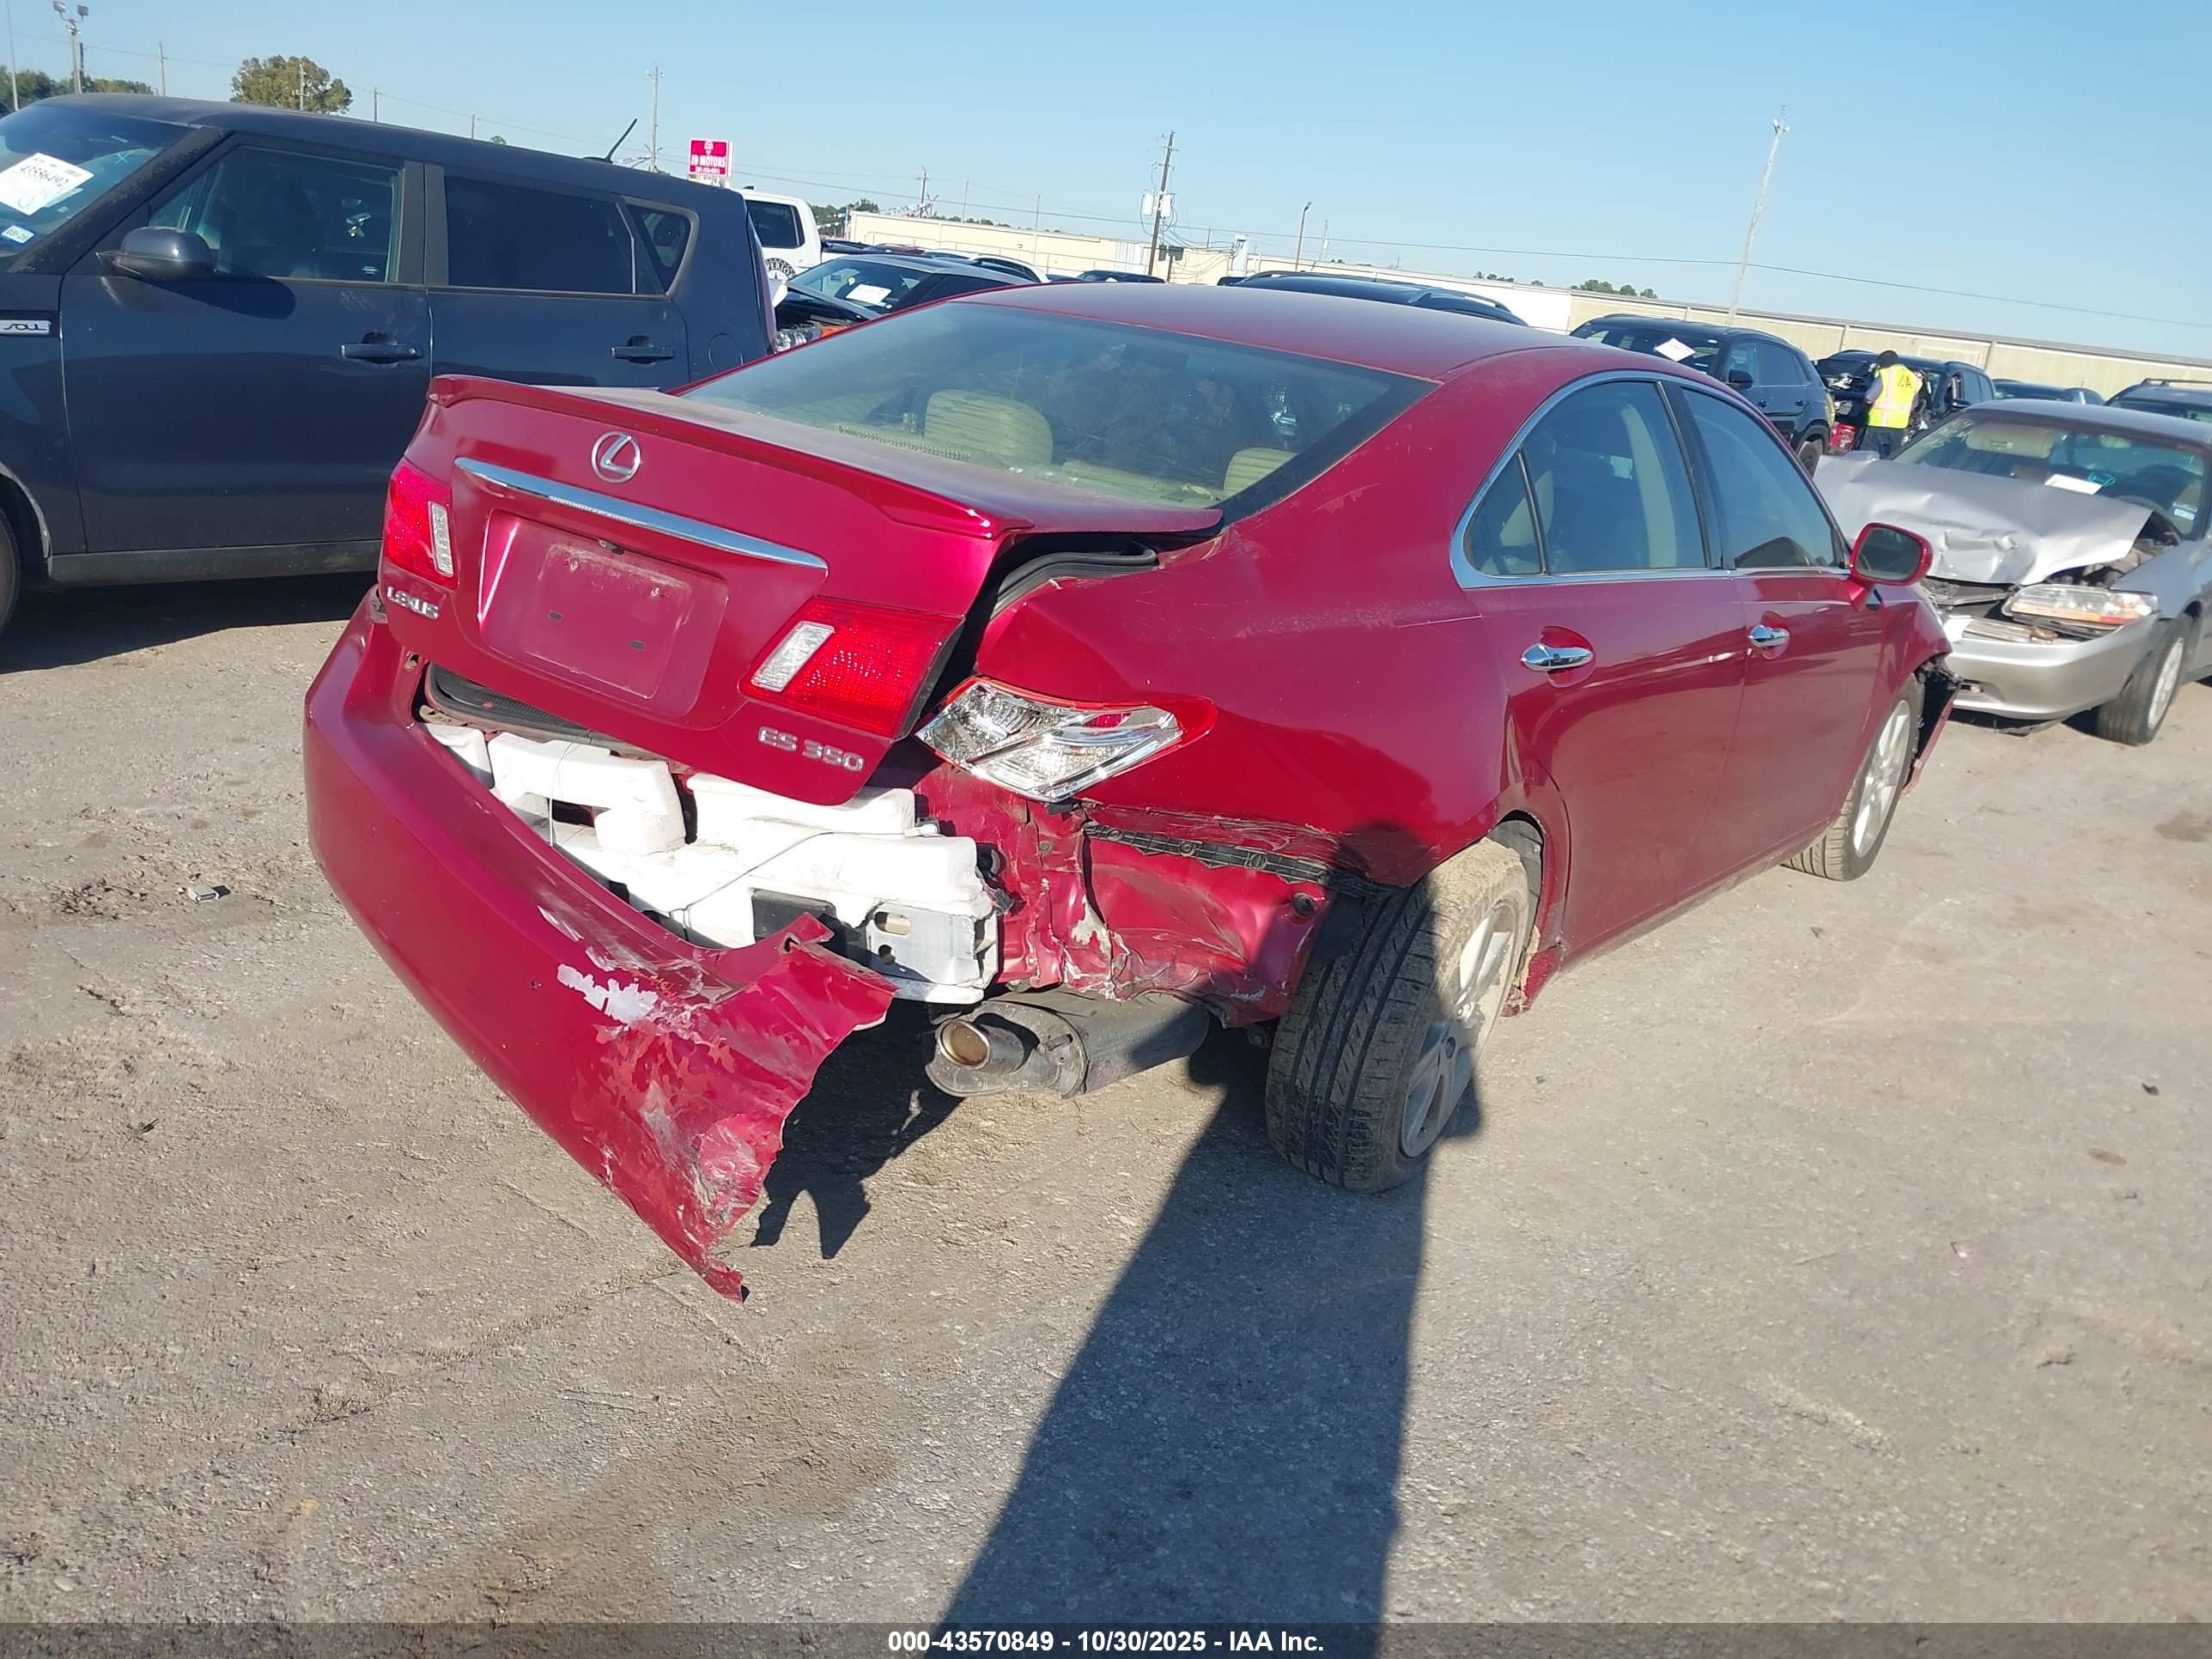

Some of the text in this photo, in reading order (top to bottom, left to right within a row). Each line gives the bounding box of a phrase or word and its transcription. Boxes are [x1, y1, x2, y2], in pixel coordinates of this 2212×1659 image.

[699, 155, 726, 168] MOTORS
[765, 261, 794, 279] PERIOR
[386, 586, 440, 619] LEXUS
[758, 726, 865, 772] ES 350
